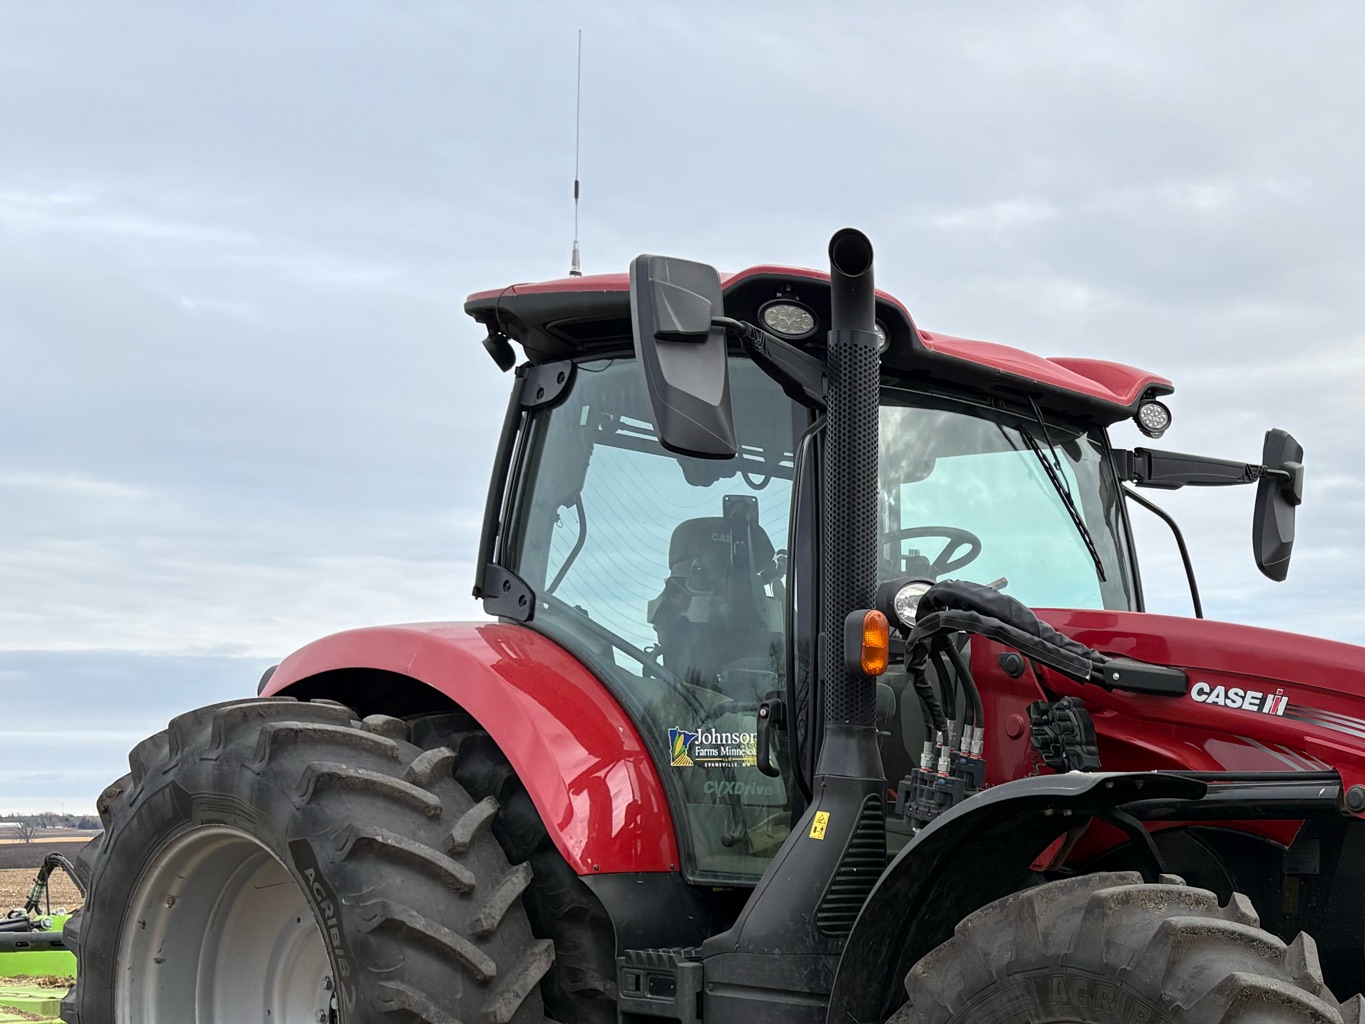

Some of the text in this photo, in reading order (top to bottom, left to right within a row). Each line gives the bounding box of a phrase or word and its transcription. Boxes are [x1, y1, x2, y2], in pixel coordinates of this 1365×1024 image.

[1191, 682, 1262, 712] CASE
[695, 745, 757, 757] Farms Minnesot
[703, 780, 774, 796] CVXDrive
[303, 867, 356, 1015] AGRIBIB 2
